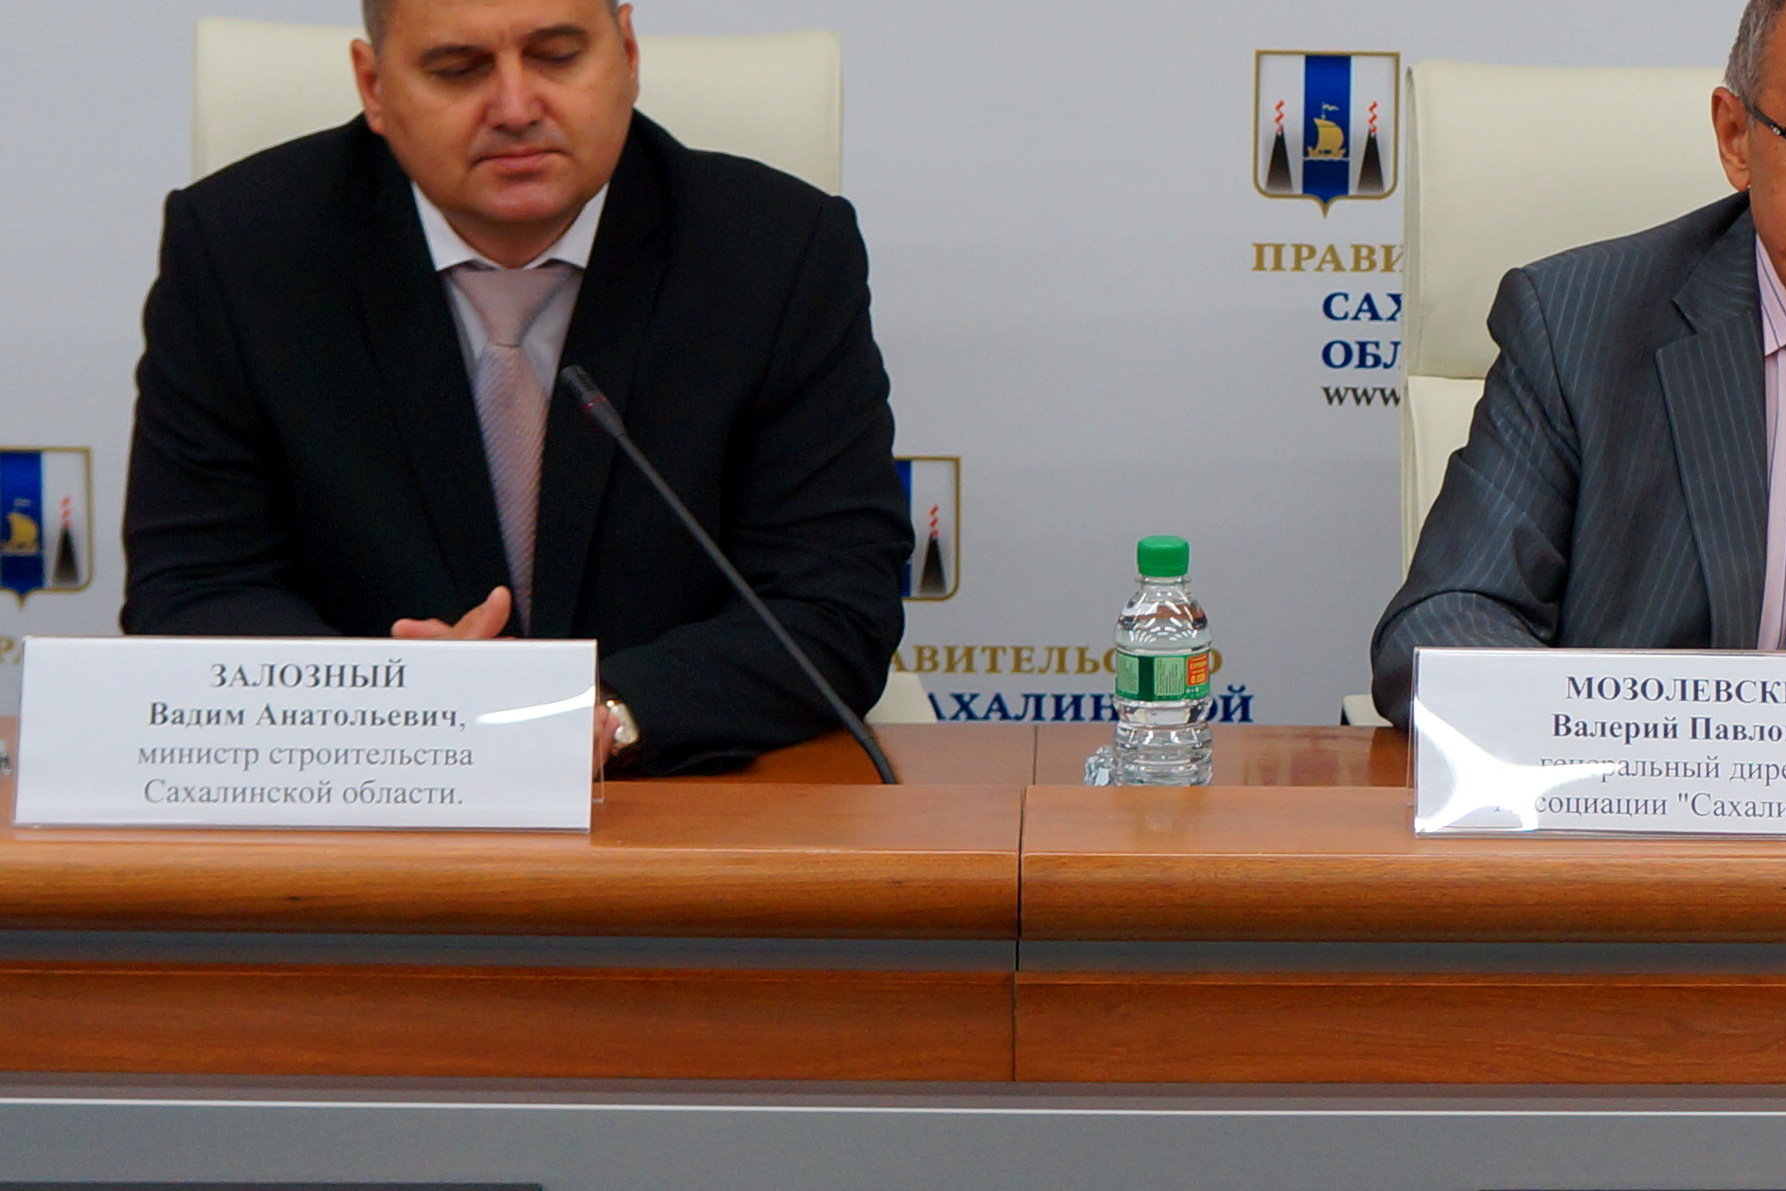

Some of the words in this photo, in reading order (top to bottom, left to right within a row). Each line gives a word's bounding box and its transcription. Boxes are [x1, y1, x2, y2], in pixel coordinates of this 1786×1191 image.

[210, 659, 406, 689] ЗАЛОЗНЫЙ
[149, 703, 245, 728] Вадим
[255, 702, 466, 731] Анатольевич,
[1552, 713, 1677, 744] Валерий
[137, 746, 259, 771] министр
[268, 746, 474, 771] строительства
[144, 778, 333, 806] Сахалинской
[342, 778, 464, 806] области.
